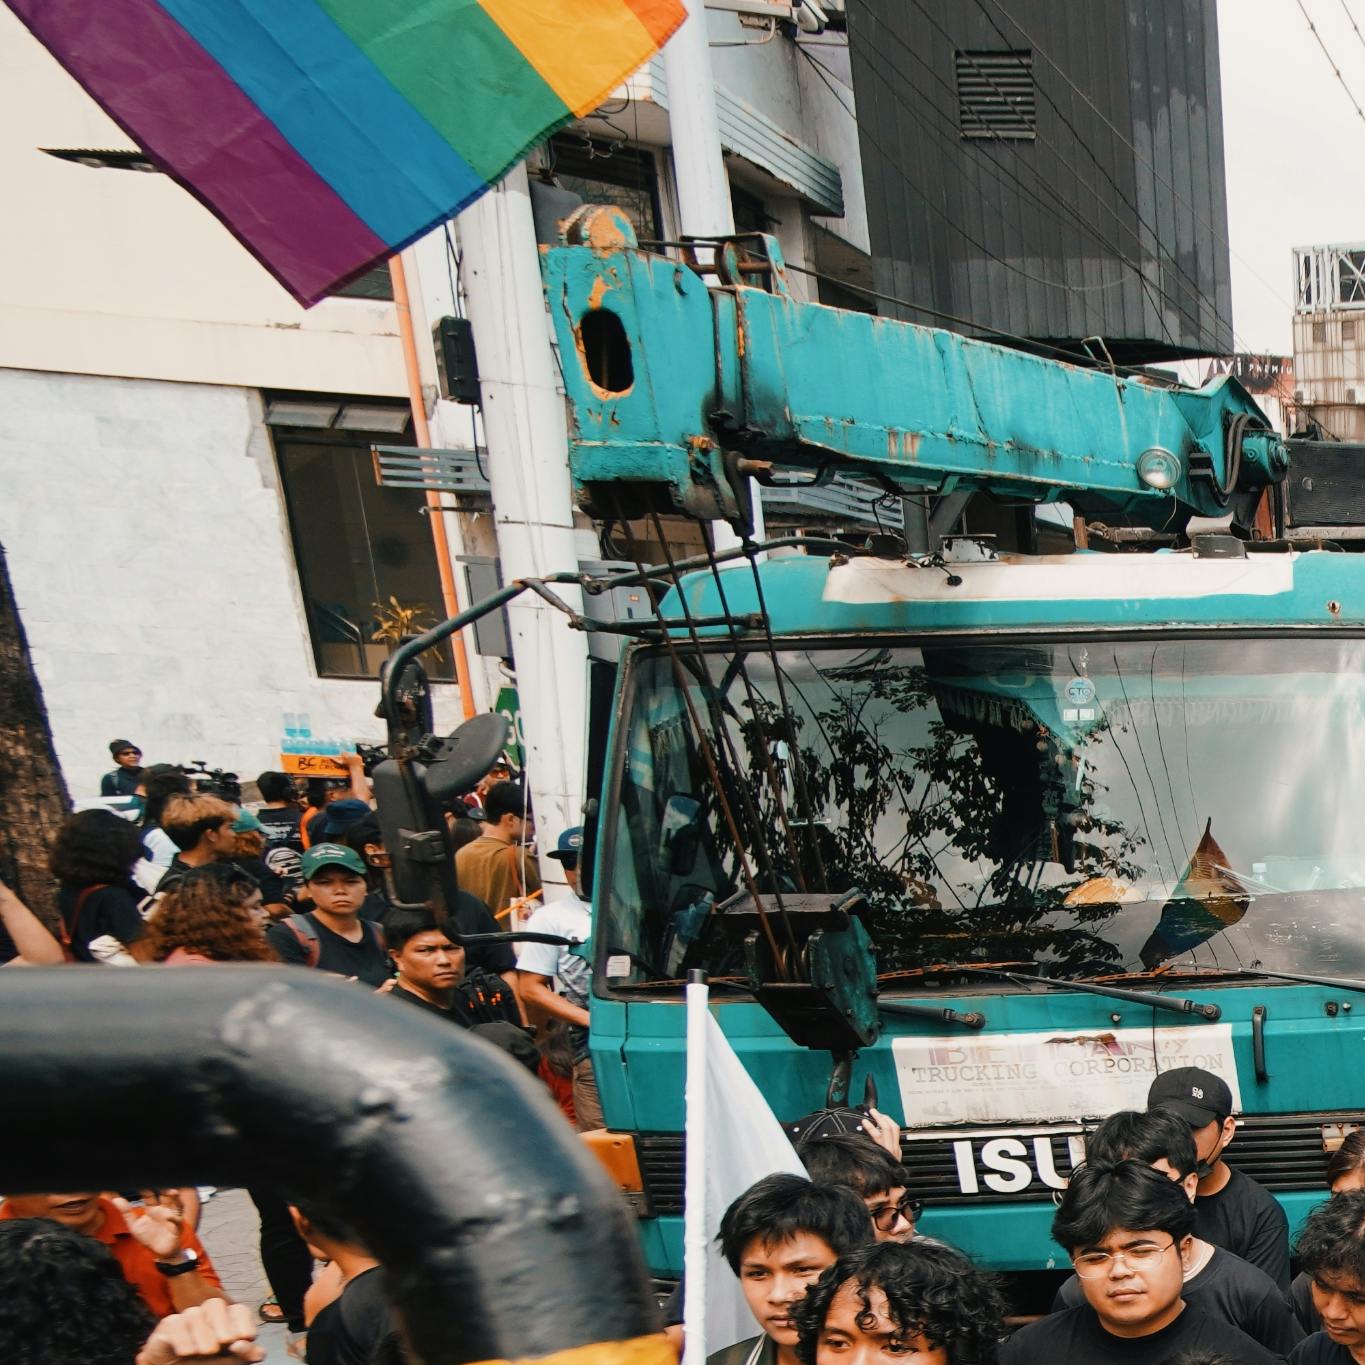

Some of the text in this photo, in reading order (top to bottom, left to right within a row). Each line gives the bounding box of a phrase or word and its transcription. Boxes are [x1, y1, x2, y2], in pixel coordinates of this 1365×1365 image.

[911, 1051, 1225, 1084] TRUCKING CORPORATION
[953, 1136, 1088, 1194] ISU
